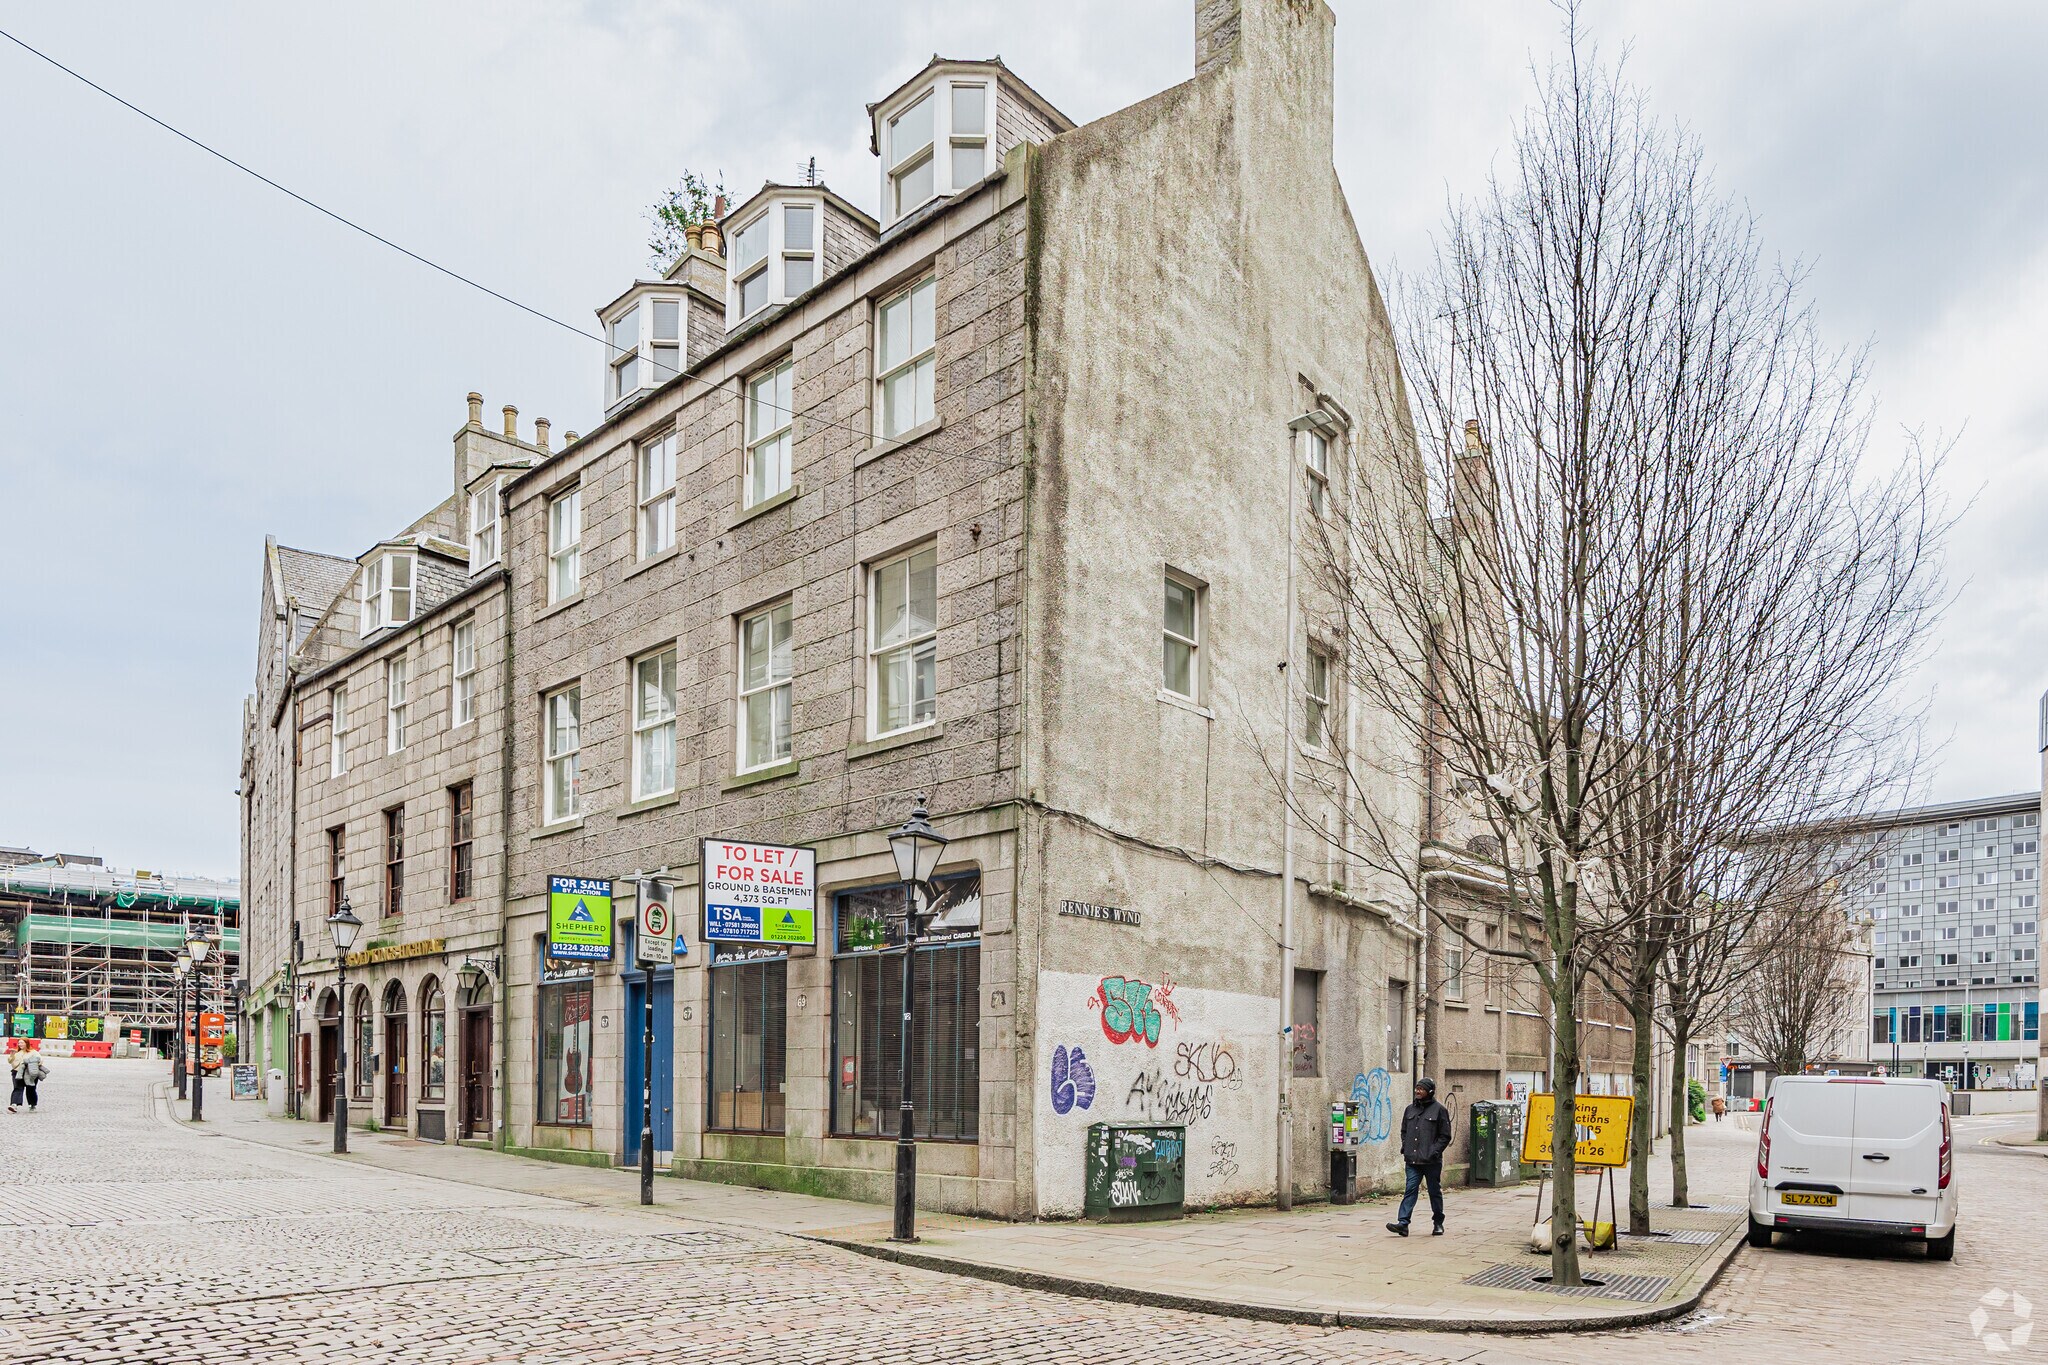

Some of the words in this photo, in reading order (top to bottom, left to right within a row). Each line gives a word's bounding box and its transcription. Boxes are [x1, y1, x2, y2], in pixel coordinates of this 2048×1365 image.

[723, 846, 746, 860] TO
[754, 848, 784, 864] LET
[790, 850, 798, 868] /
[717, 865, 754, 881] FOR
[760, 869, 803, 885] SALE
[553, 878, 576, 888] FOR
[580, 880, 610, 891] SALE
[708, 882, 751, 892] GROUND
[763, 886, 812, 897] BASEMENT
[734, 894, 759, 904] 4,373
[762, 896, 789, 905] SQ.FT
[714, 907, 742, 920] TSA
[1061, 901, 1109, 919] RENNIE'S
[1114, 909, 1140, 924] WYND
[556, 922, 606, 932] SHEPHERD
[797, 998, 806, 1007] 69
[684, 1009, 692, 1019] 67
[601, 1017, 609, 1027] 67
[1575, 1104, 1597, 1116] king
[1590, 1147, 1604, 1156] 26
[1785, 1195, 1810, 1204] SL72
[1813, 1195, 1832, 1204] XCM
